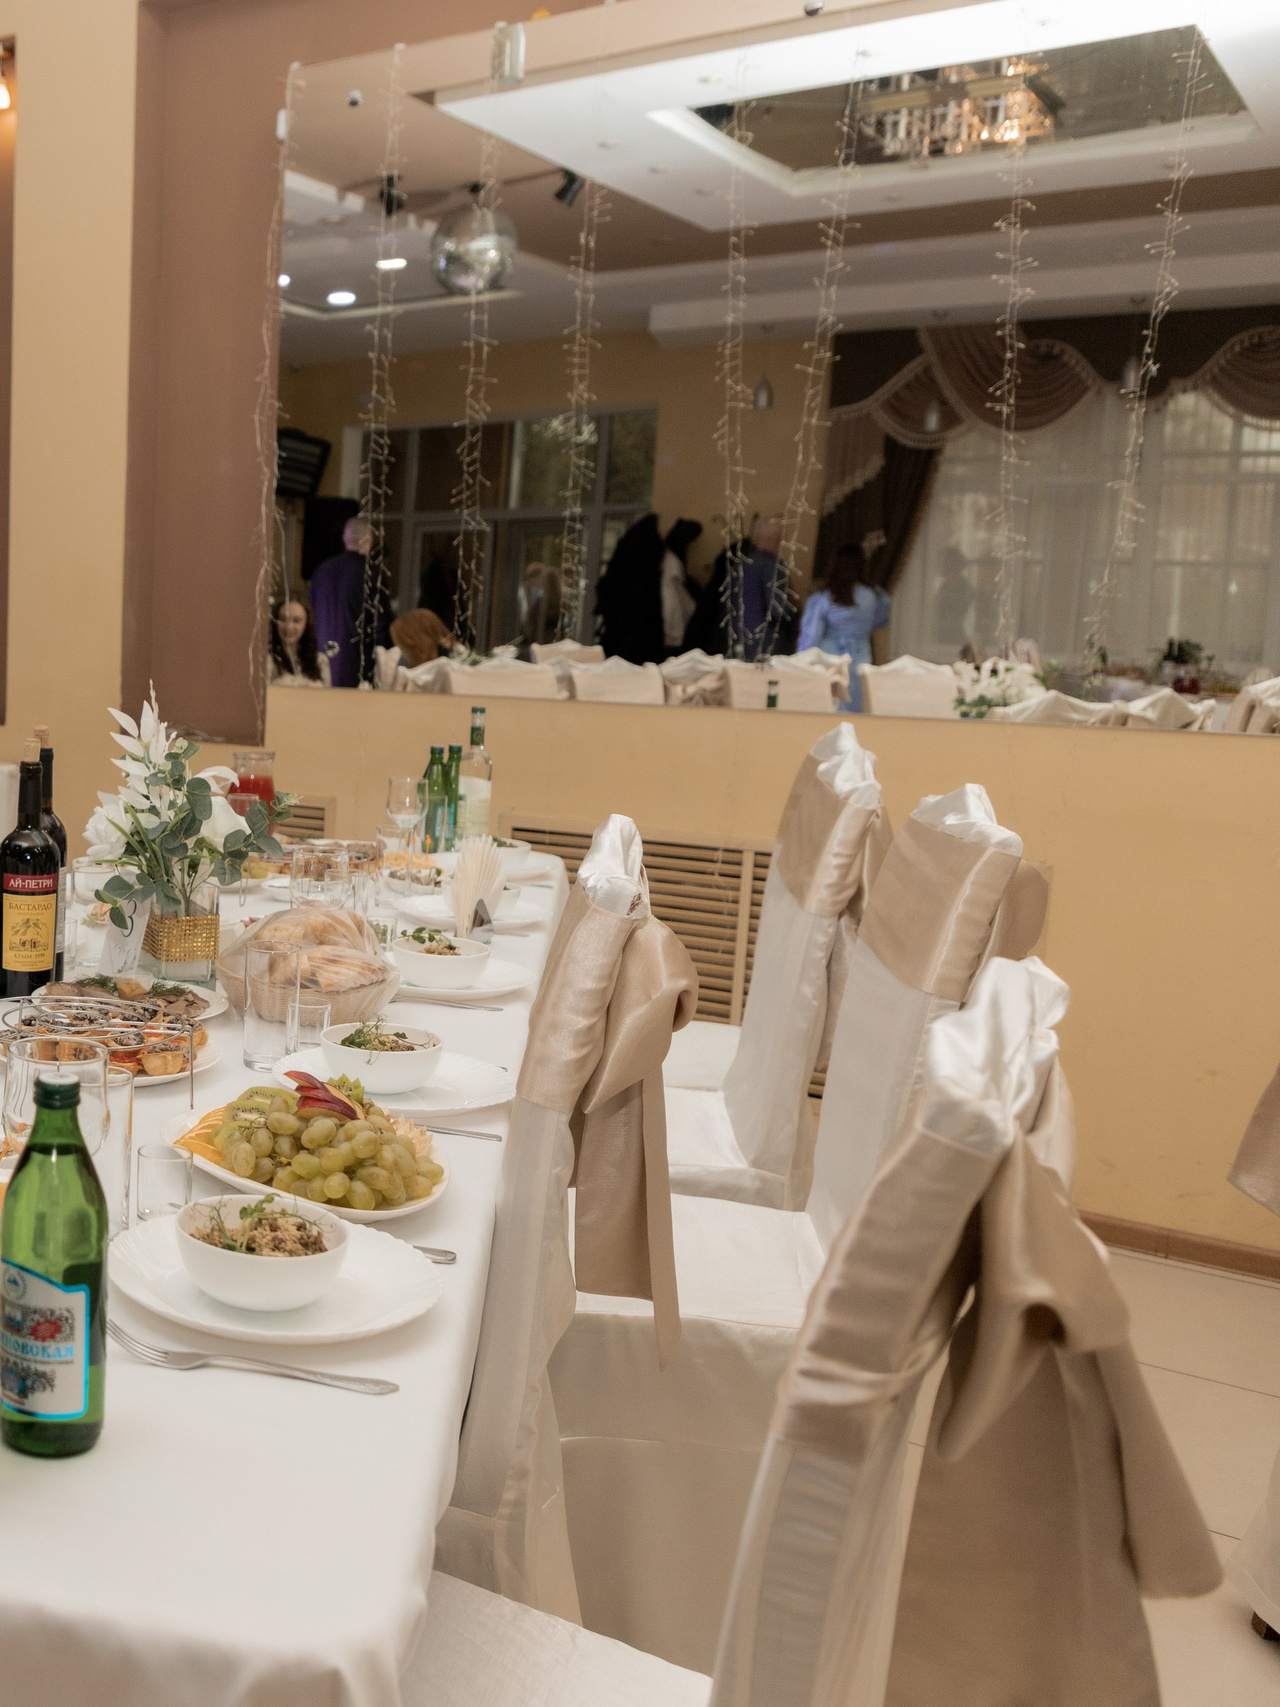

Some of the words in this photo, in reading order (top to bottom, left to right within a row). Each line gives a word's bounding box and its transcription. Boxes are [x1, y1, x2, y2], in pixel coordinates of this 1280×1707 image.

[8, 878, 53, 889] АЙ-ПЕТРИ
[8, 902, 53, 911] БАСТАРДО
[120, 899, 137, 938] 3
